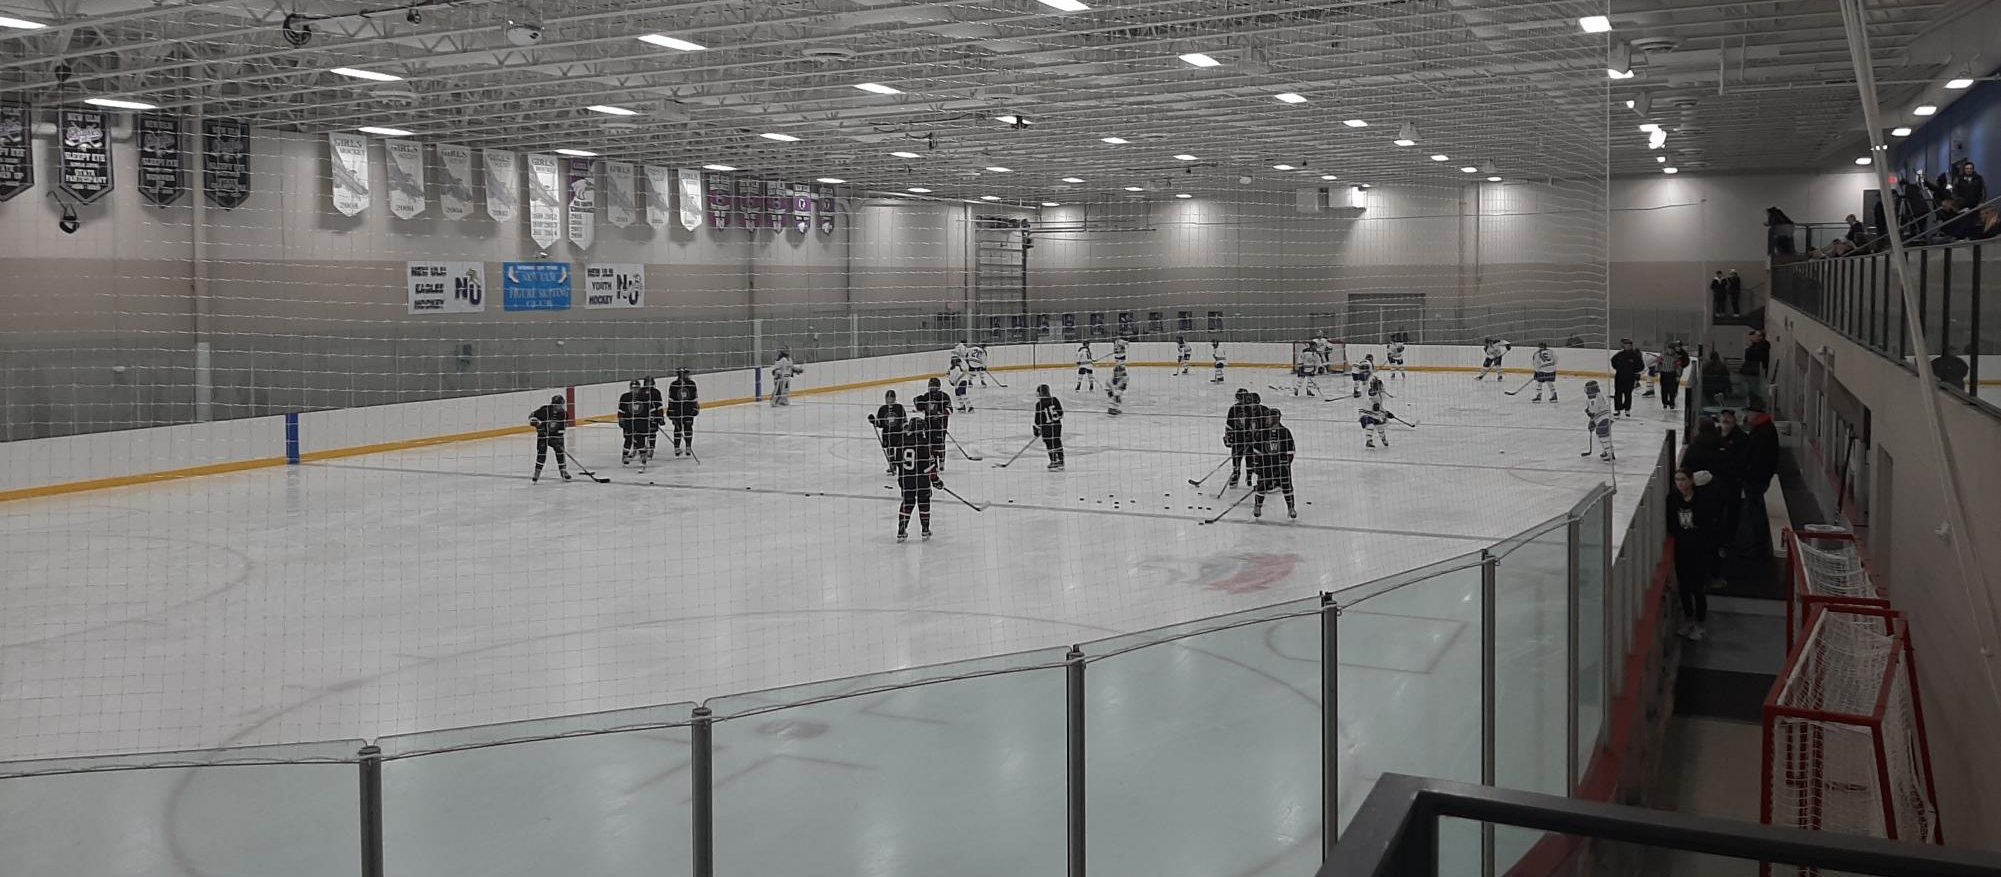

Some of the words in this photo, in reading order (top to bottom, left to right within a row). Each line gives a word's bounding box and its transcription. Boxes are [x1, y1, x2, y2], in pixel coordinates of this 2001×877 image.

[67, 113, 82, 121] NEW
[85, 114, 101, 122] ULM
[335, 139, 362, 148] GIRLS
[340, 148, 365, 156] HOCKEY
[391, 144, 418, 153] GIRLS
[64, 152, 91, 161] SLEEPY
[92, 153, 106, 162] EYE
[440, 150, 467, 159] GIRLS
[488, 154, 511, 162] GIRLS
[142, 158, 165, 166] SLEEPY
[166, 159, 179, 167] EYE
[207, 162, 233, 171] SLEEPY
[531, 158, 555, 166] GIRLS
[411, 266, 428, 276] NEW
[430, 266, 447, 276] ULM
[588, 268, 600, 277] NEW
[602, 268, 614, 277] ULM
[520, 271, 537, 281] NEW
[539, 271, 557, 281] ULM
[415, 283, 444, 294] EAGLES
[592, 281, 612, 290] YOUTH
[509, 287, 536, 298] FIGURE
[538, 287, 569, 298] SKATING
[414, 299, 444, 309] HOCKEY
[589, 295, 613, 304] HOCKEY
[1044, 405, 1060, 423] 15
[903, 448, 916, 470] 9
